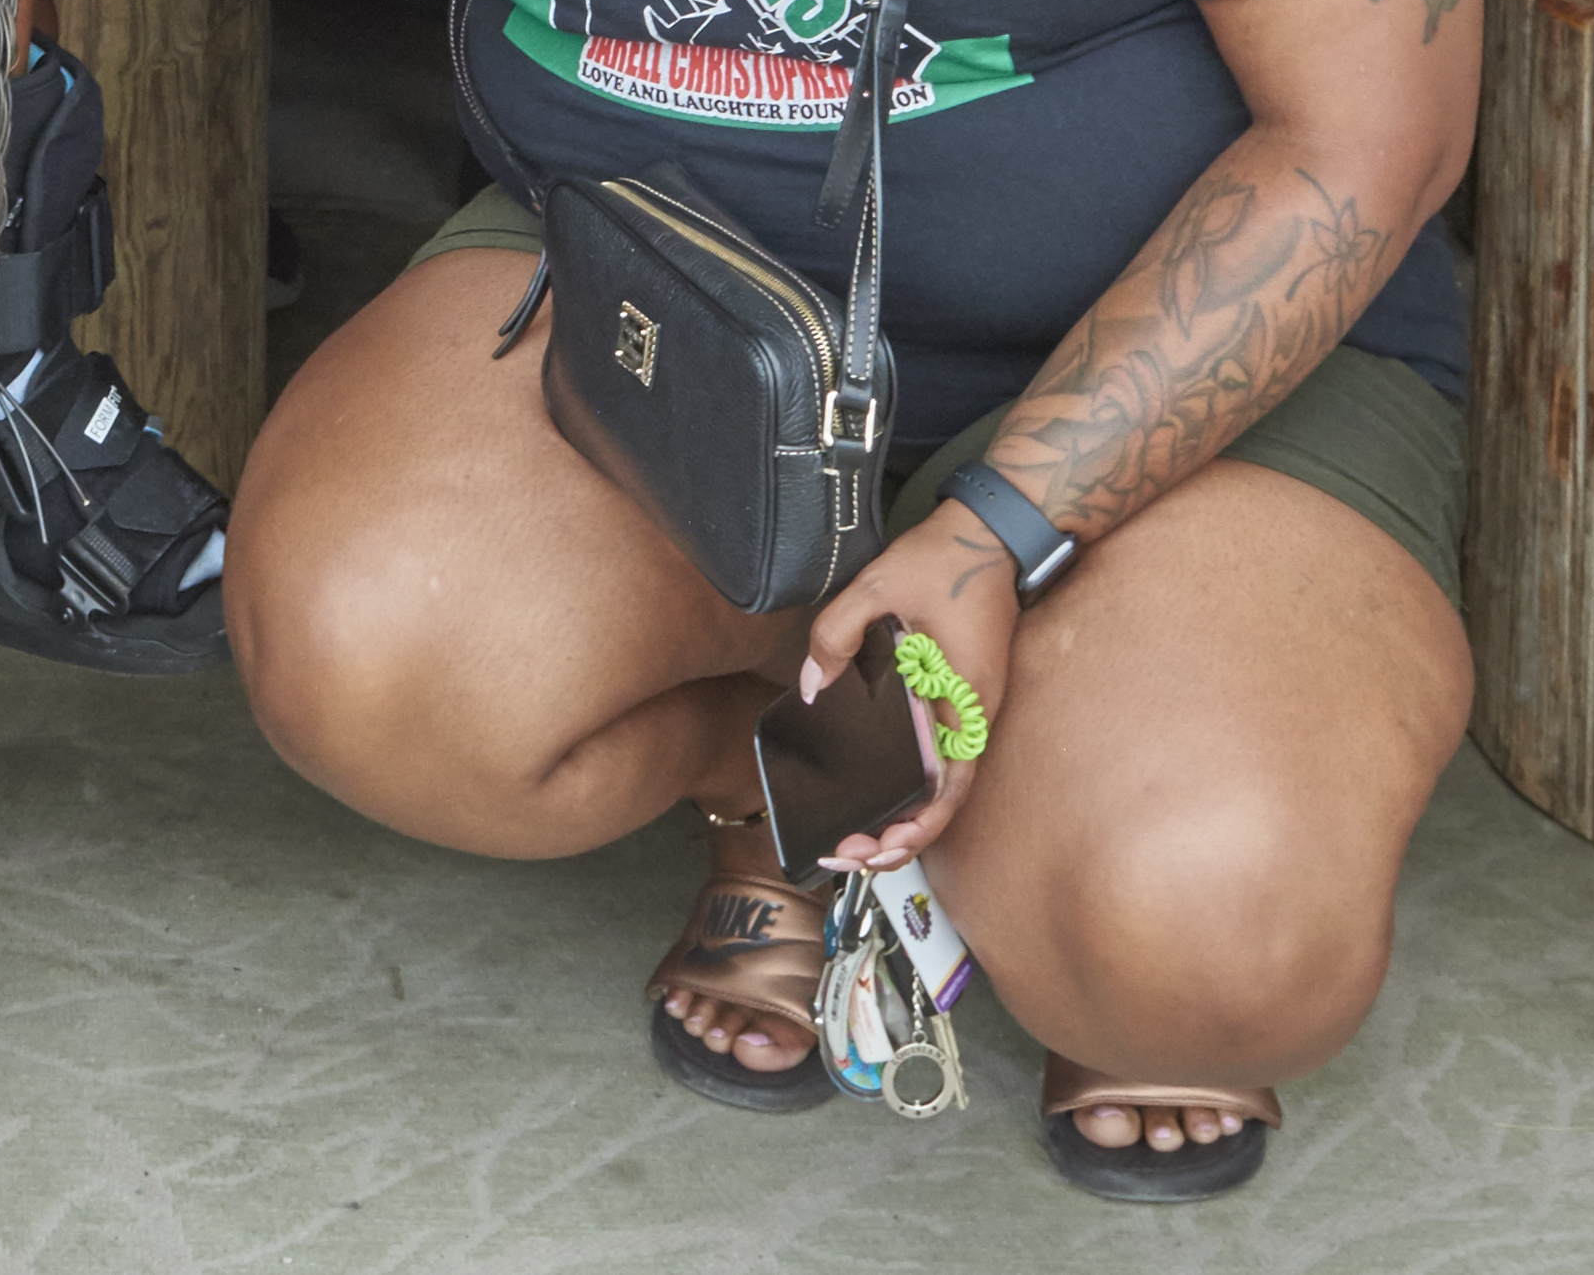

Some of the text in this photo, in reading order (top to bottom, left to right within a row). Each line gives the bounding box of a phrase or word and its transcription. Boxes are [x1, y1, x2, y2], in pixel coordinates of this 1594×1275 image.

[582, 62, 624, 93] LOVE
[628, 83, 669, 105] AND
[673, 92, 784, 121] LAUGHTER
[703, 895, 785, 941] NIKE
